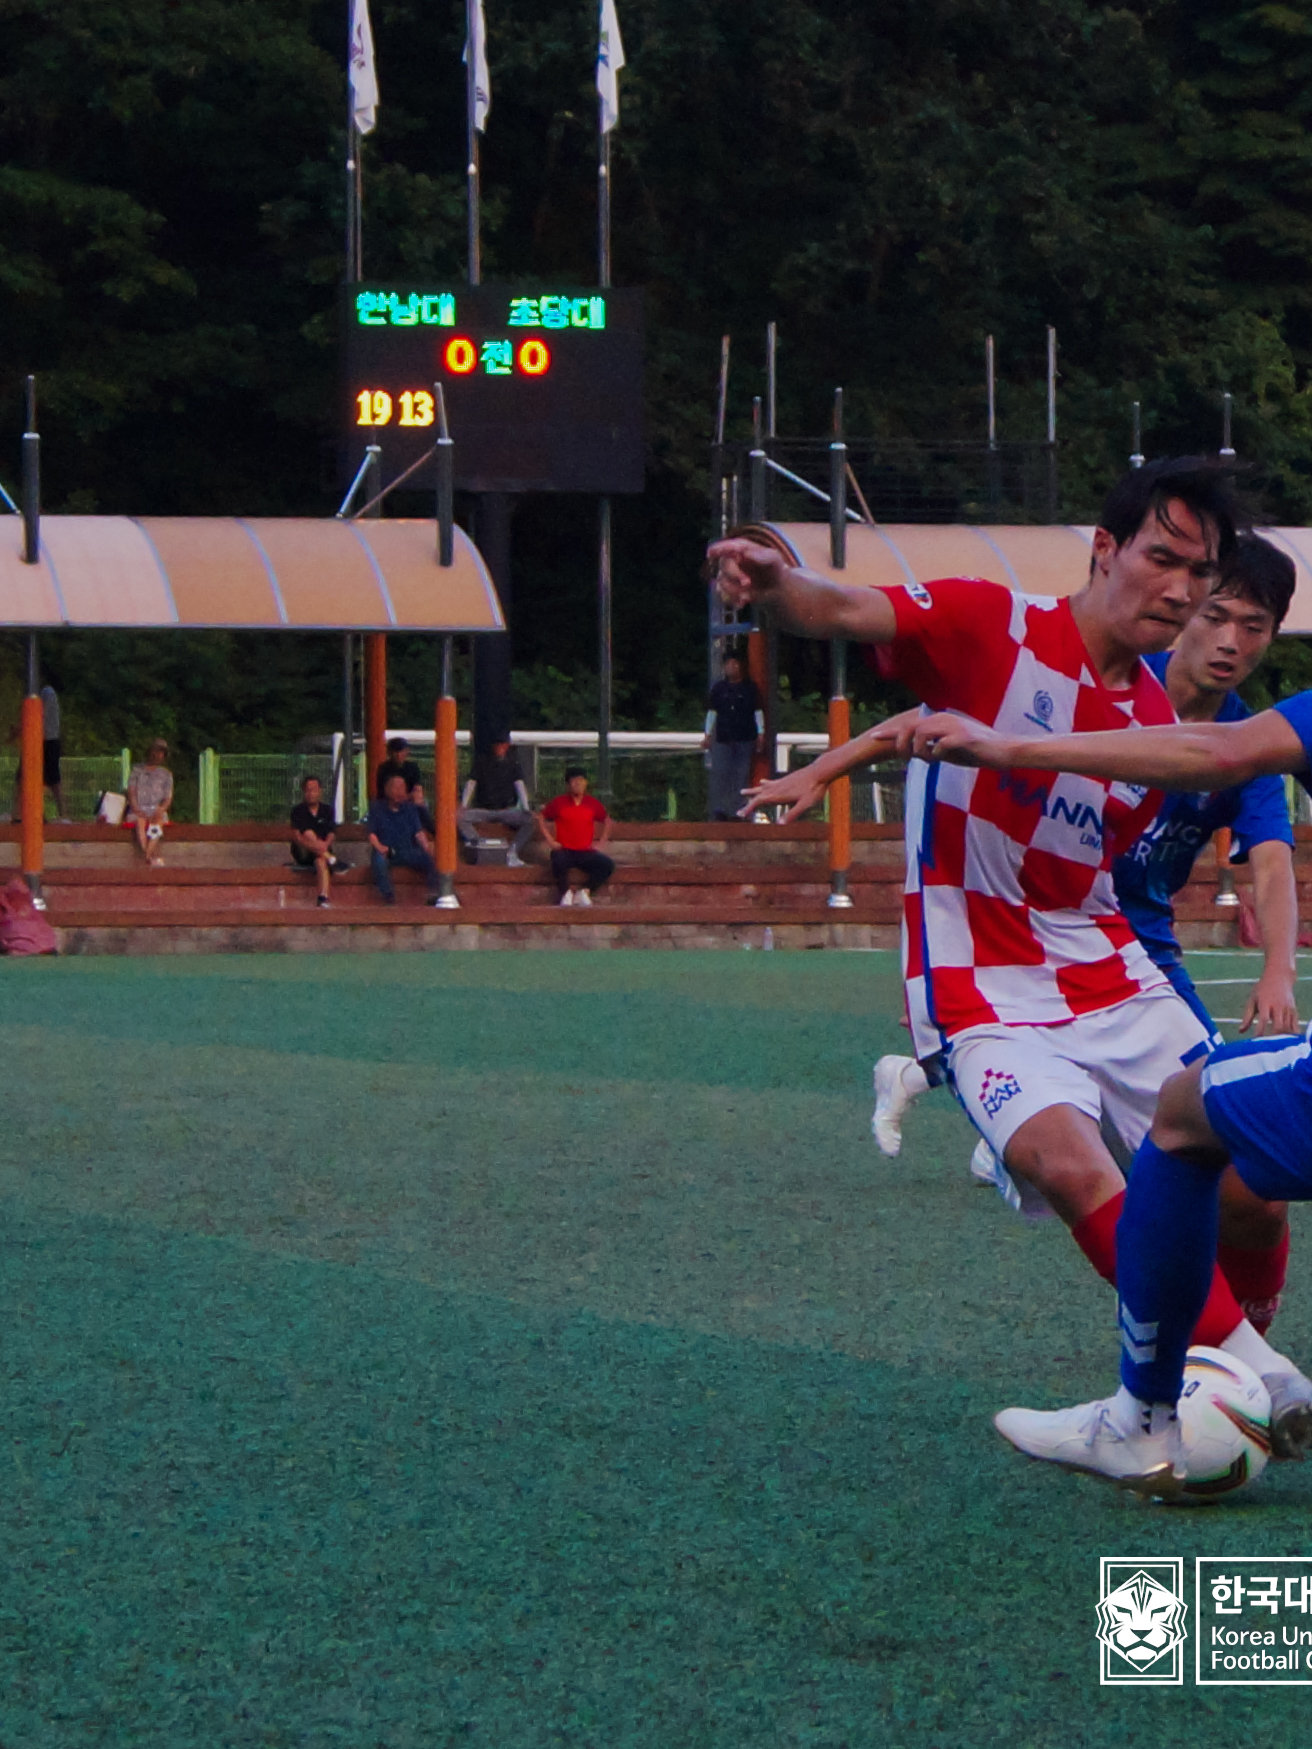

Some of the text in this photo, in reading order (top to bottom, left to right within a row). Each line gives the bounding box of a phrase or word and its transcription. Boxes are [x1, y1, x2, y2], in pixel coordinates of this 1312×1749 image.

[507, 295, 606, 330] 초당대
[447, 338, 550, 375] 0 전 0
[356, 389, 435, 427] 19 13
